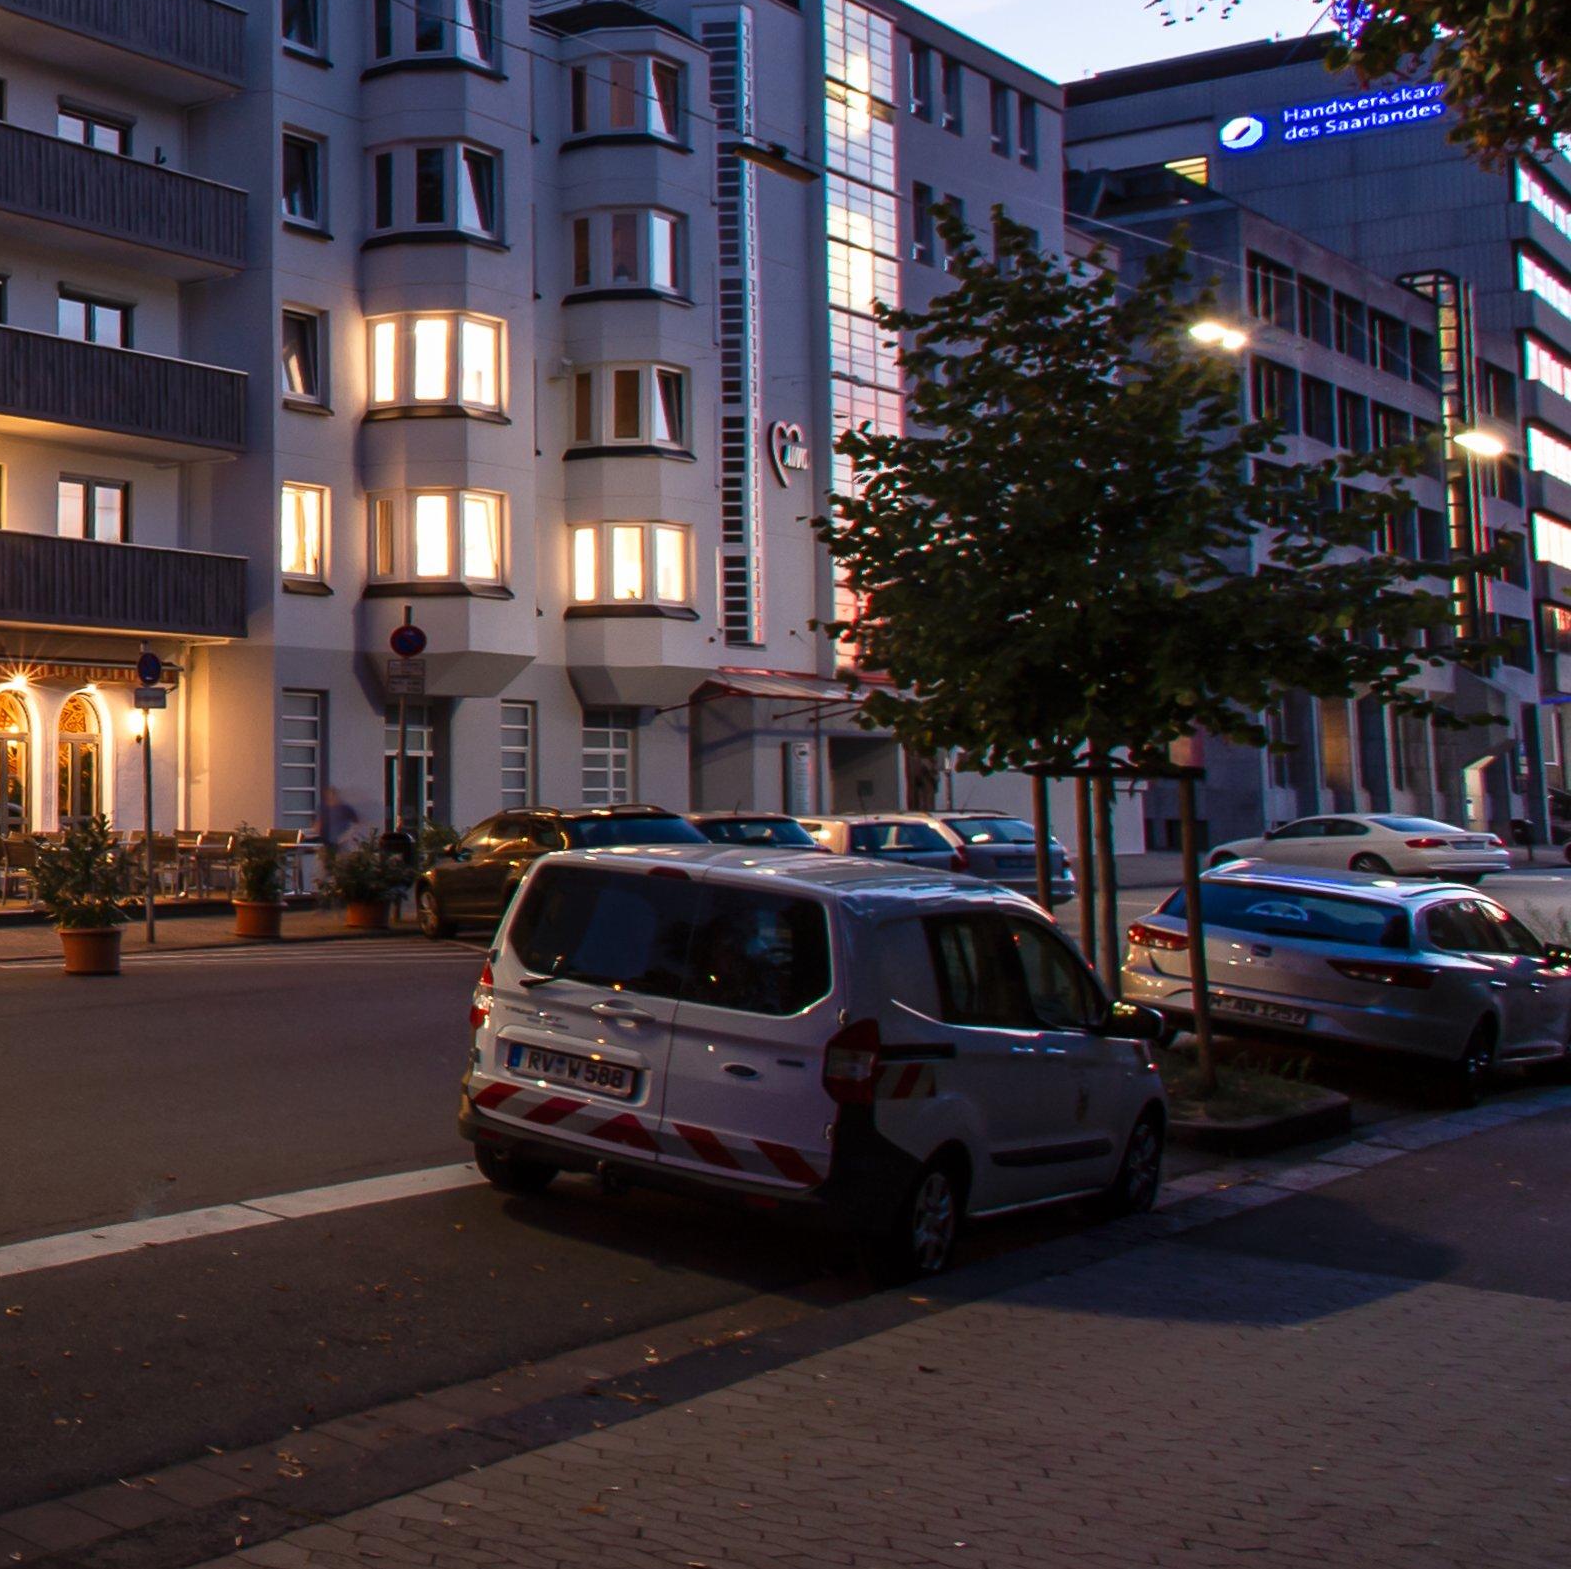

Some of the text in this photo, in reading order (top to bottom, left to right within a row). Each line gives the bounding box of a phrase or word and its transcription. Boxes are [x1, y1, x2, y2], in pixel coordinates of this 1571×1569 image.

[1284, 103, 1442, 141] des Saarlandes
[527, 1050, 553, 1073] RV
